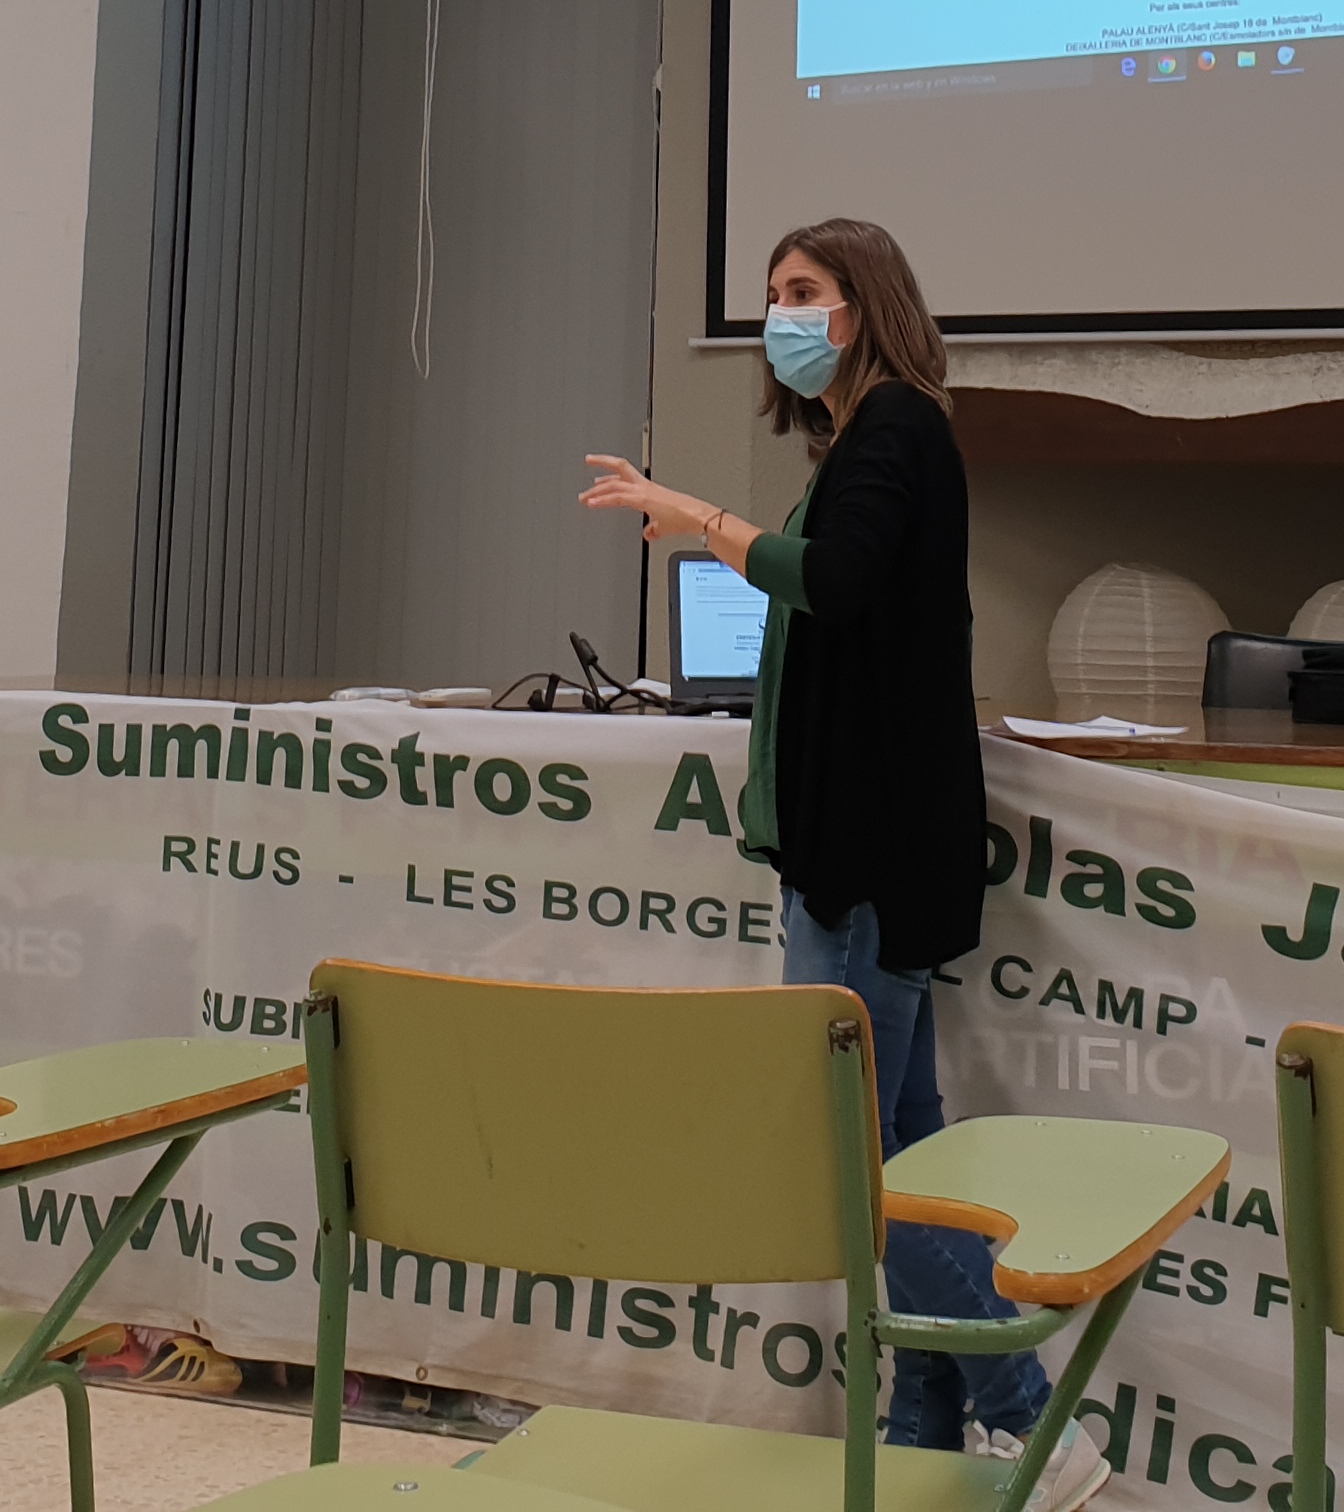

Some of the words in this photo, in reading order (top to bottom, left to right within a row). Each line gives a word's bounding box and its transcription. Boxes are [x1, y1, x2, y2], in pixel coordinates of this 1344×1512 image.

[40, 702, 593, 824] Suministros
[162, 834, 302, 888] REUS
[405, 862, 516, 916] LES
[542, 881, 787, 951] BORGE
[990, 954, 1198, 1037] CAMP
